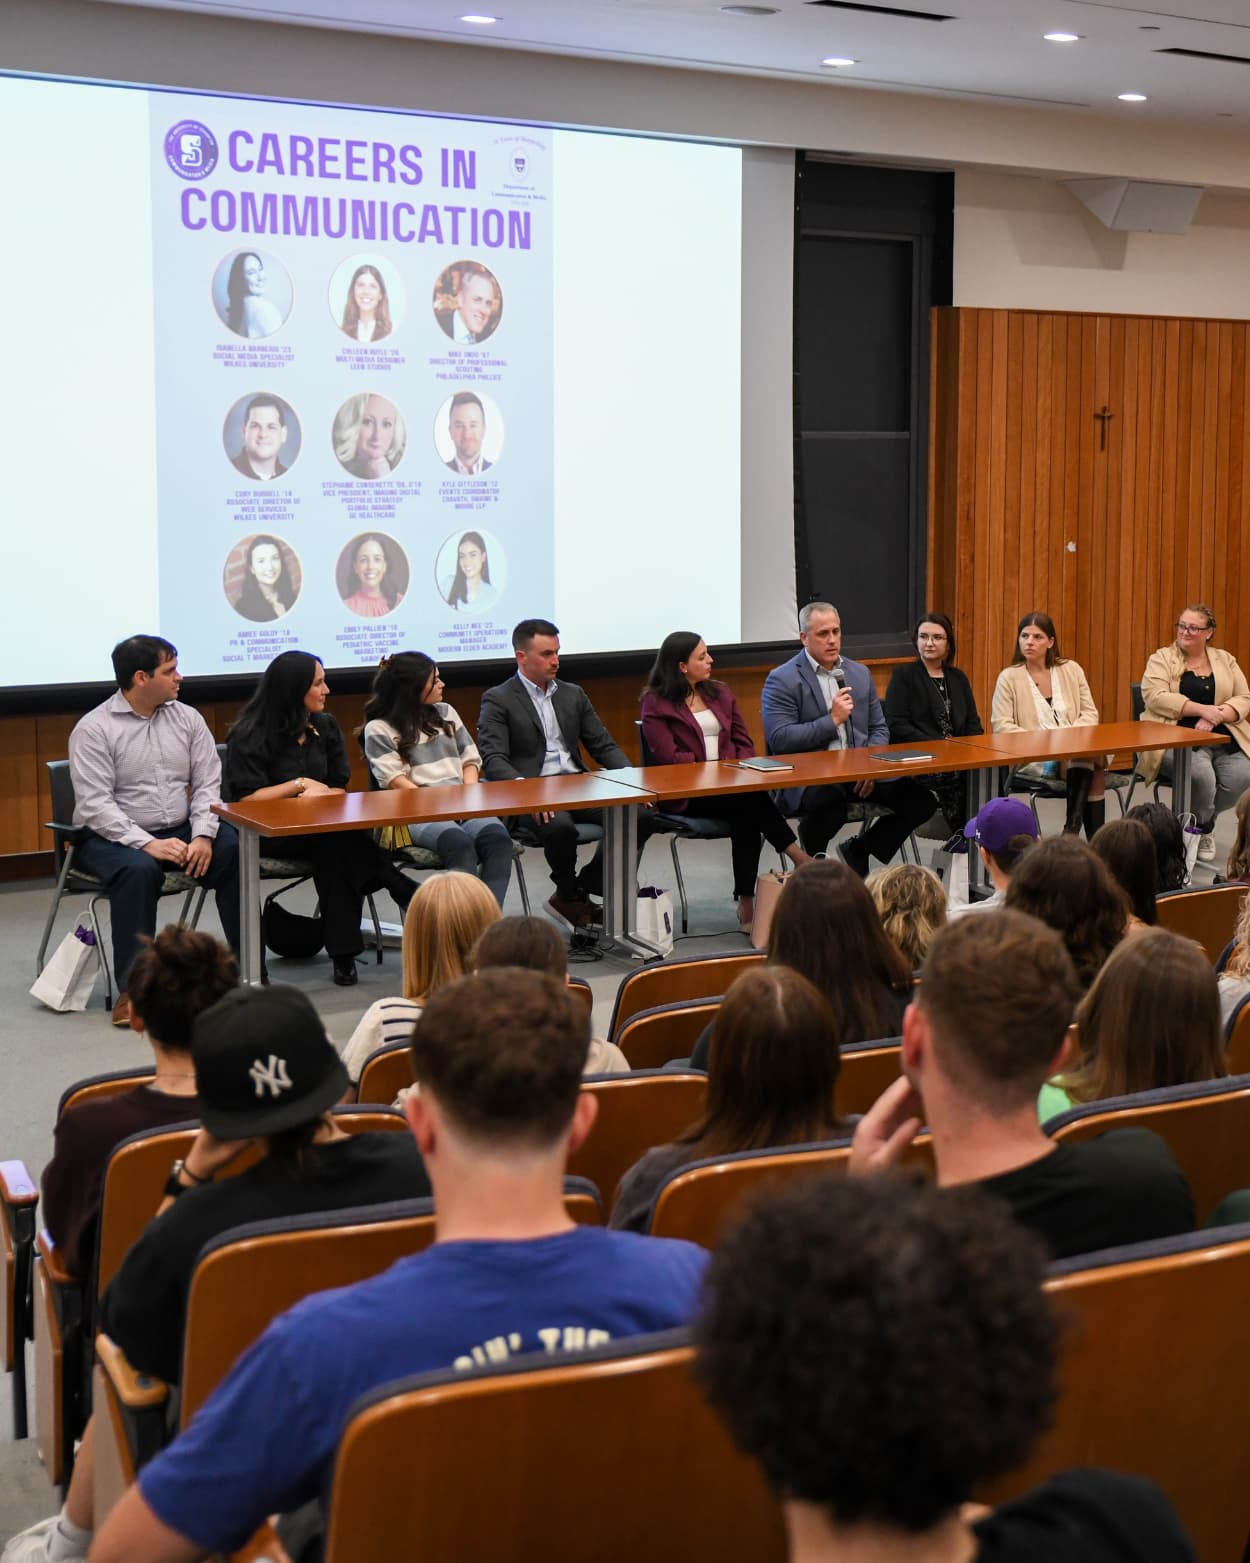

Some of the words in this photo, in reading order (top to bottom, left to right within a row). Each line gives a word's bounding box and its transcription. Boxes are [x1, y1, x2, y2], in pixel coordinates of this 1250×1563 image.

[228, 129, 423, 186] CAREERS
[440, 148, 476, 190] IN
[181, 187, 531, 250] COMMUNICATION
[248, 1054, 294, 1098] NY
